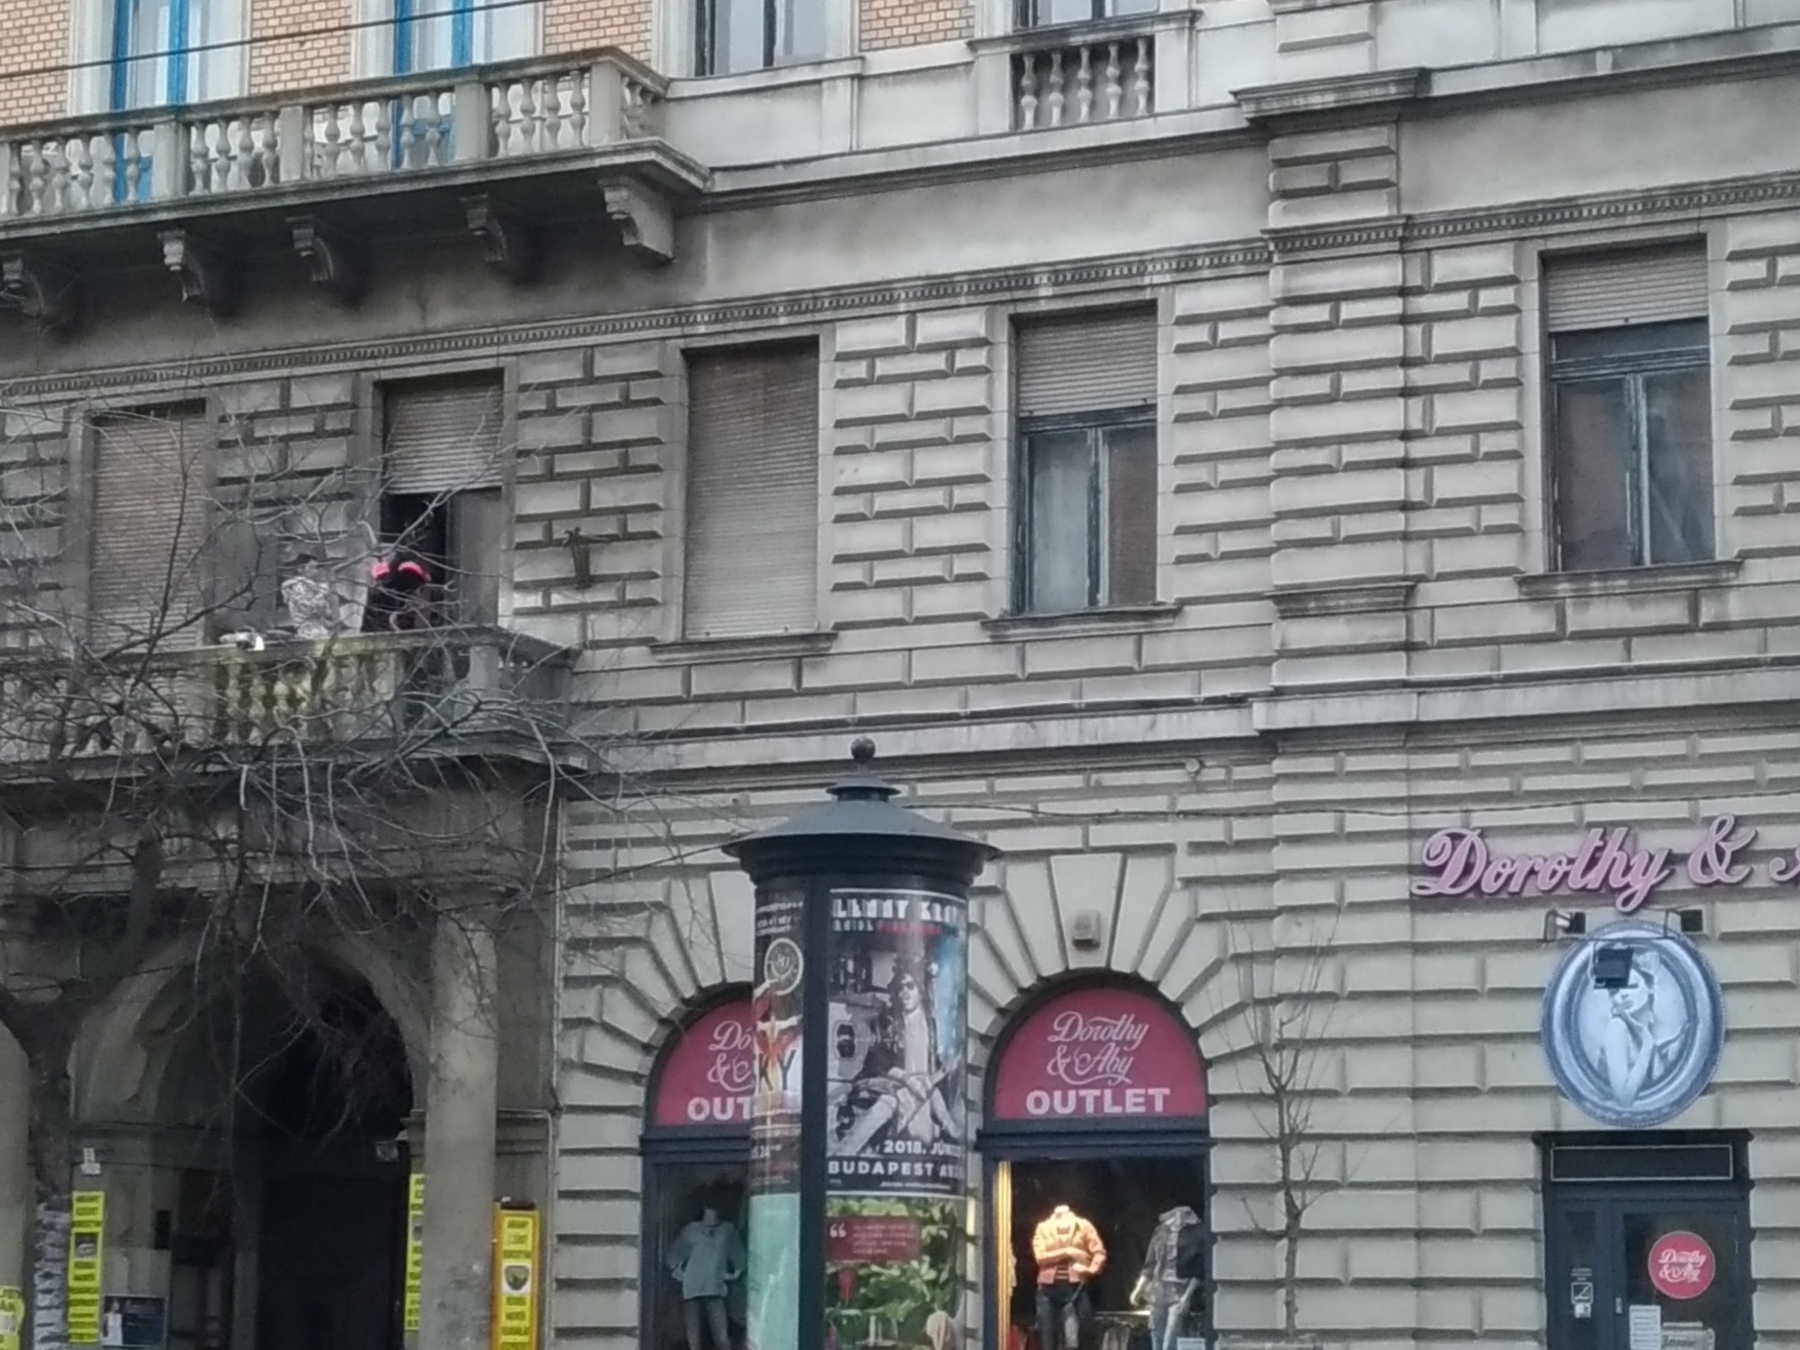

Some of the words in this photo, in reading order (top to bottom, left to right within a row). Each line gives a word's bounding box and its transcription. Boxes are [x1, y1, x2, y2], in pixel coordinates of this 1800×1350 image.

[1410, 827, 1676, 913] Dorothy
[1688, 813, 1756, 885] &
[1047, 1011, 1150, 1051] Dorothy
[1046, 1045, 1072, 1080] &
[1074, 1043, 1134, 1086] Aby
[687, 1096, 752, 1122] OUT
[1026, 1088, 1170, 1114] OUTLET
[883, 1140, 927, 1156] 2018.
[827, 1160, 934, 1177] BUDAPEST
